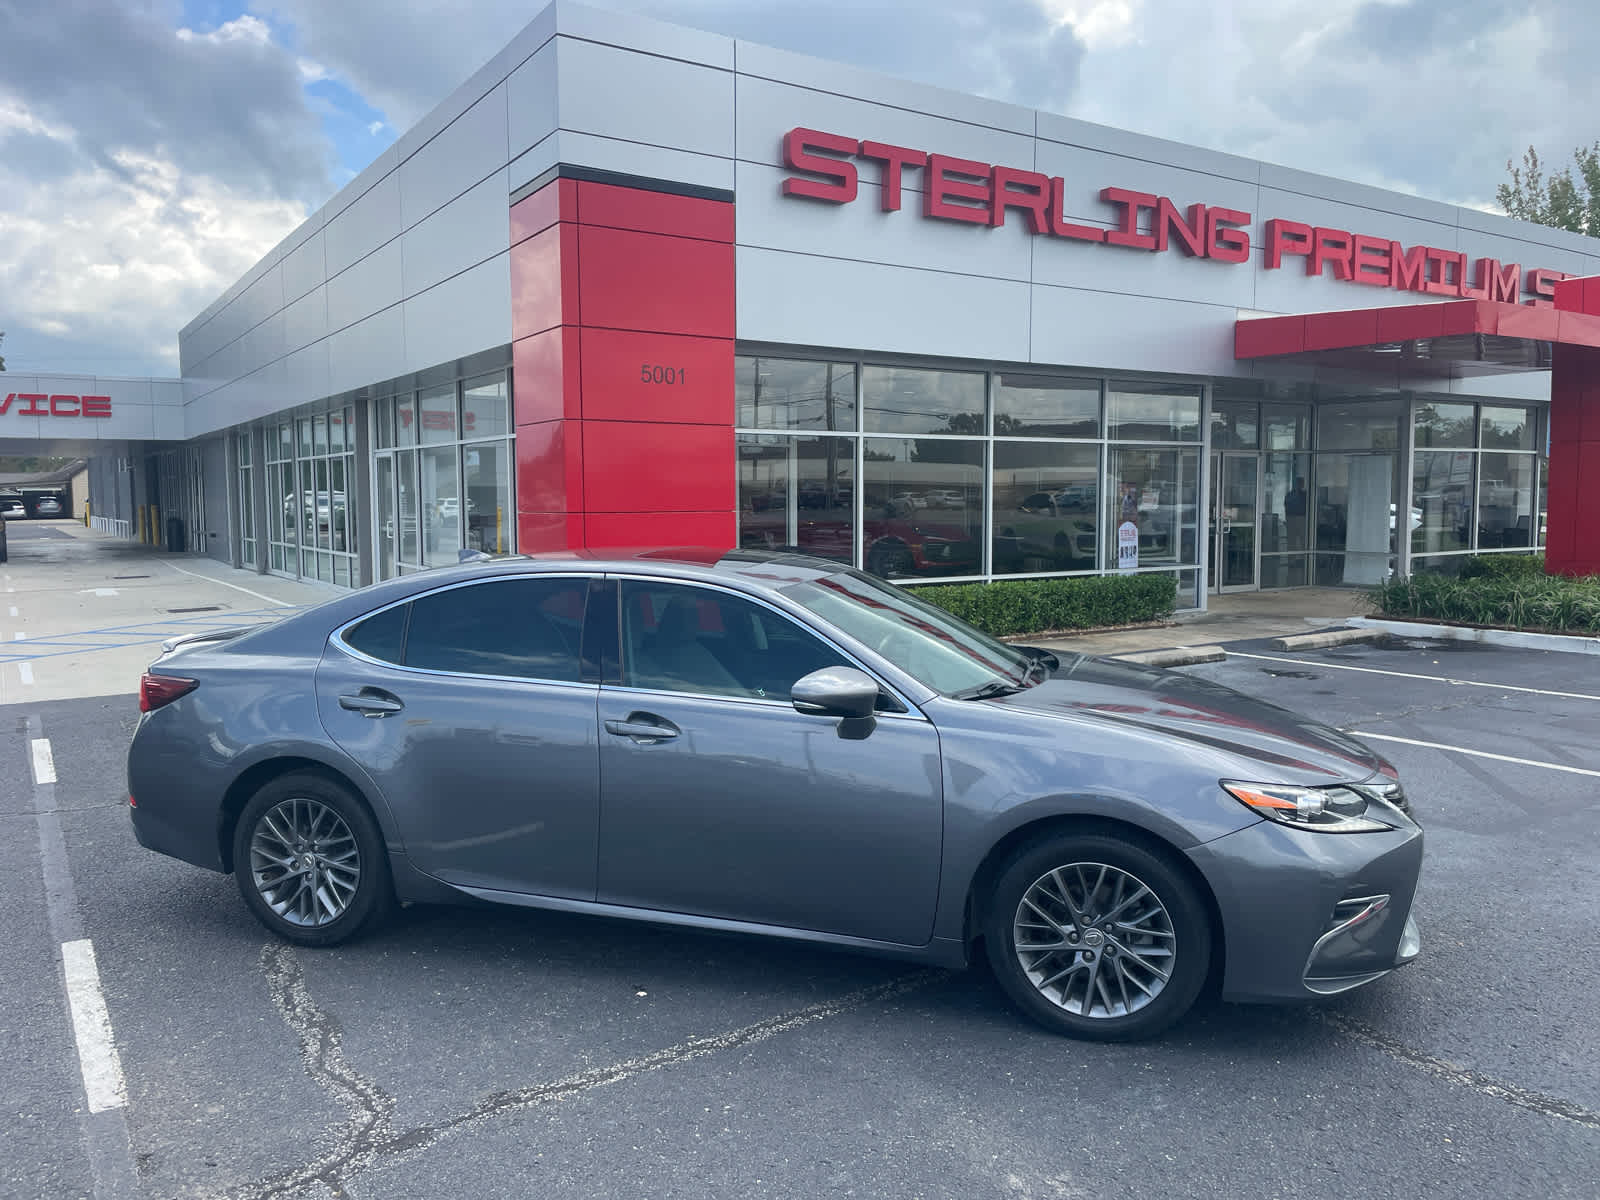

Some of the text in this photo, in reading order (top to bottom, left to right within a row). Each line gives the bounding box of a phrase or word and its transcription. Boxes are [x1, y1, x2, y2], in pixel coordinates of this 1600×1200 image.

[783, 127, 1251, 264] STERLING
[1264, 219, 1521, 305] PREMIUM
[640, 364, 686, 385] 5001
